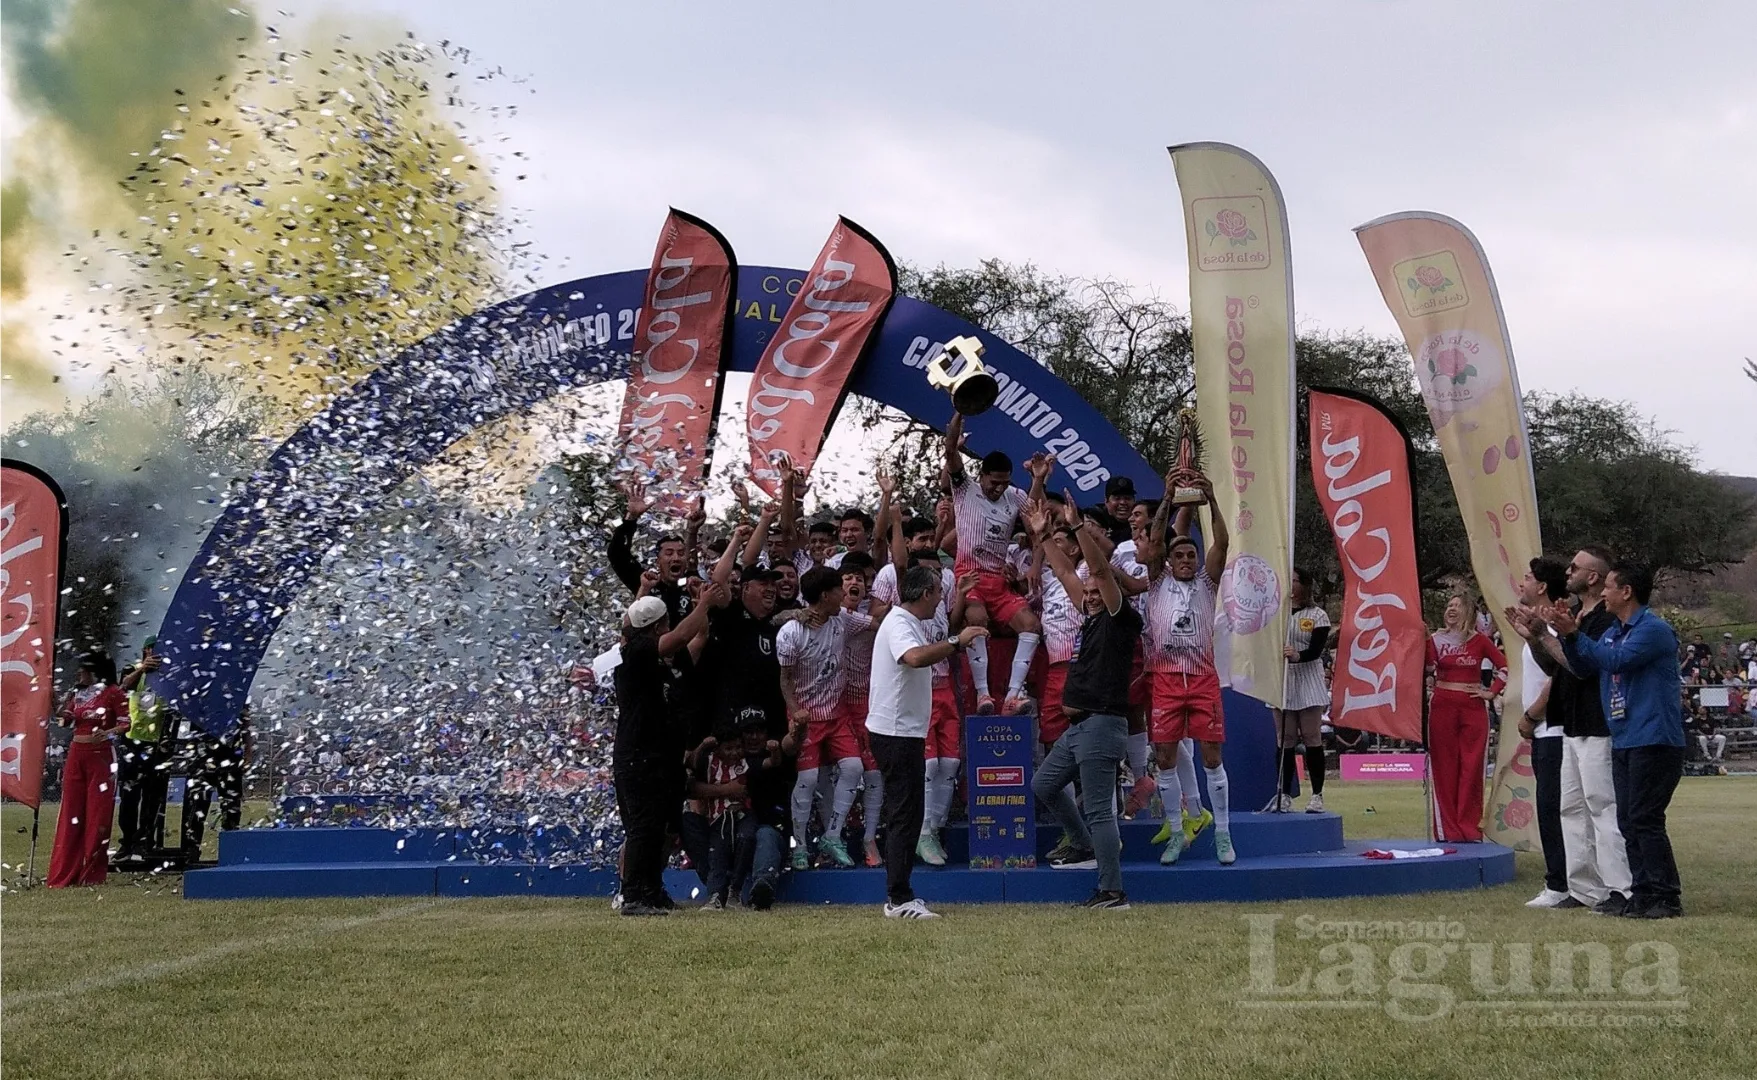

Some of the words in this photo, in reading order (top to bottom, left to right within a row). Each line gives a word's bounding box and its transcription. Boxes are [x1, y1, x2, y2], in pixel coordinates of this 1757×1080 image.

[762, 276, 804, 296] CO
[733, 299, 782, 323] JAL
[1044, 428, 1111, 492] 2026
[976, 796, 986, 806] LA
[986, 796, 1006, 806] GRAN
[1006, 796, 1026, 805] FINAL
